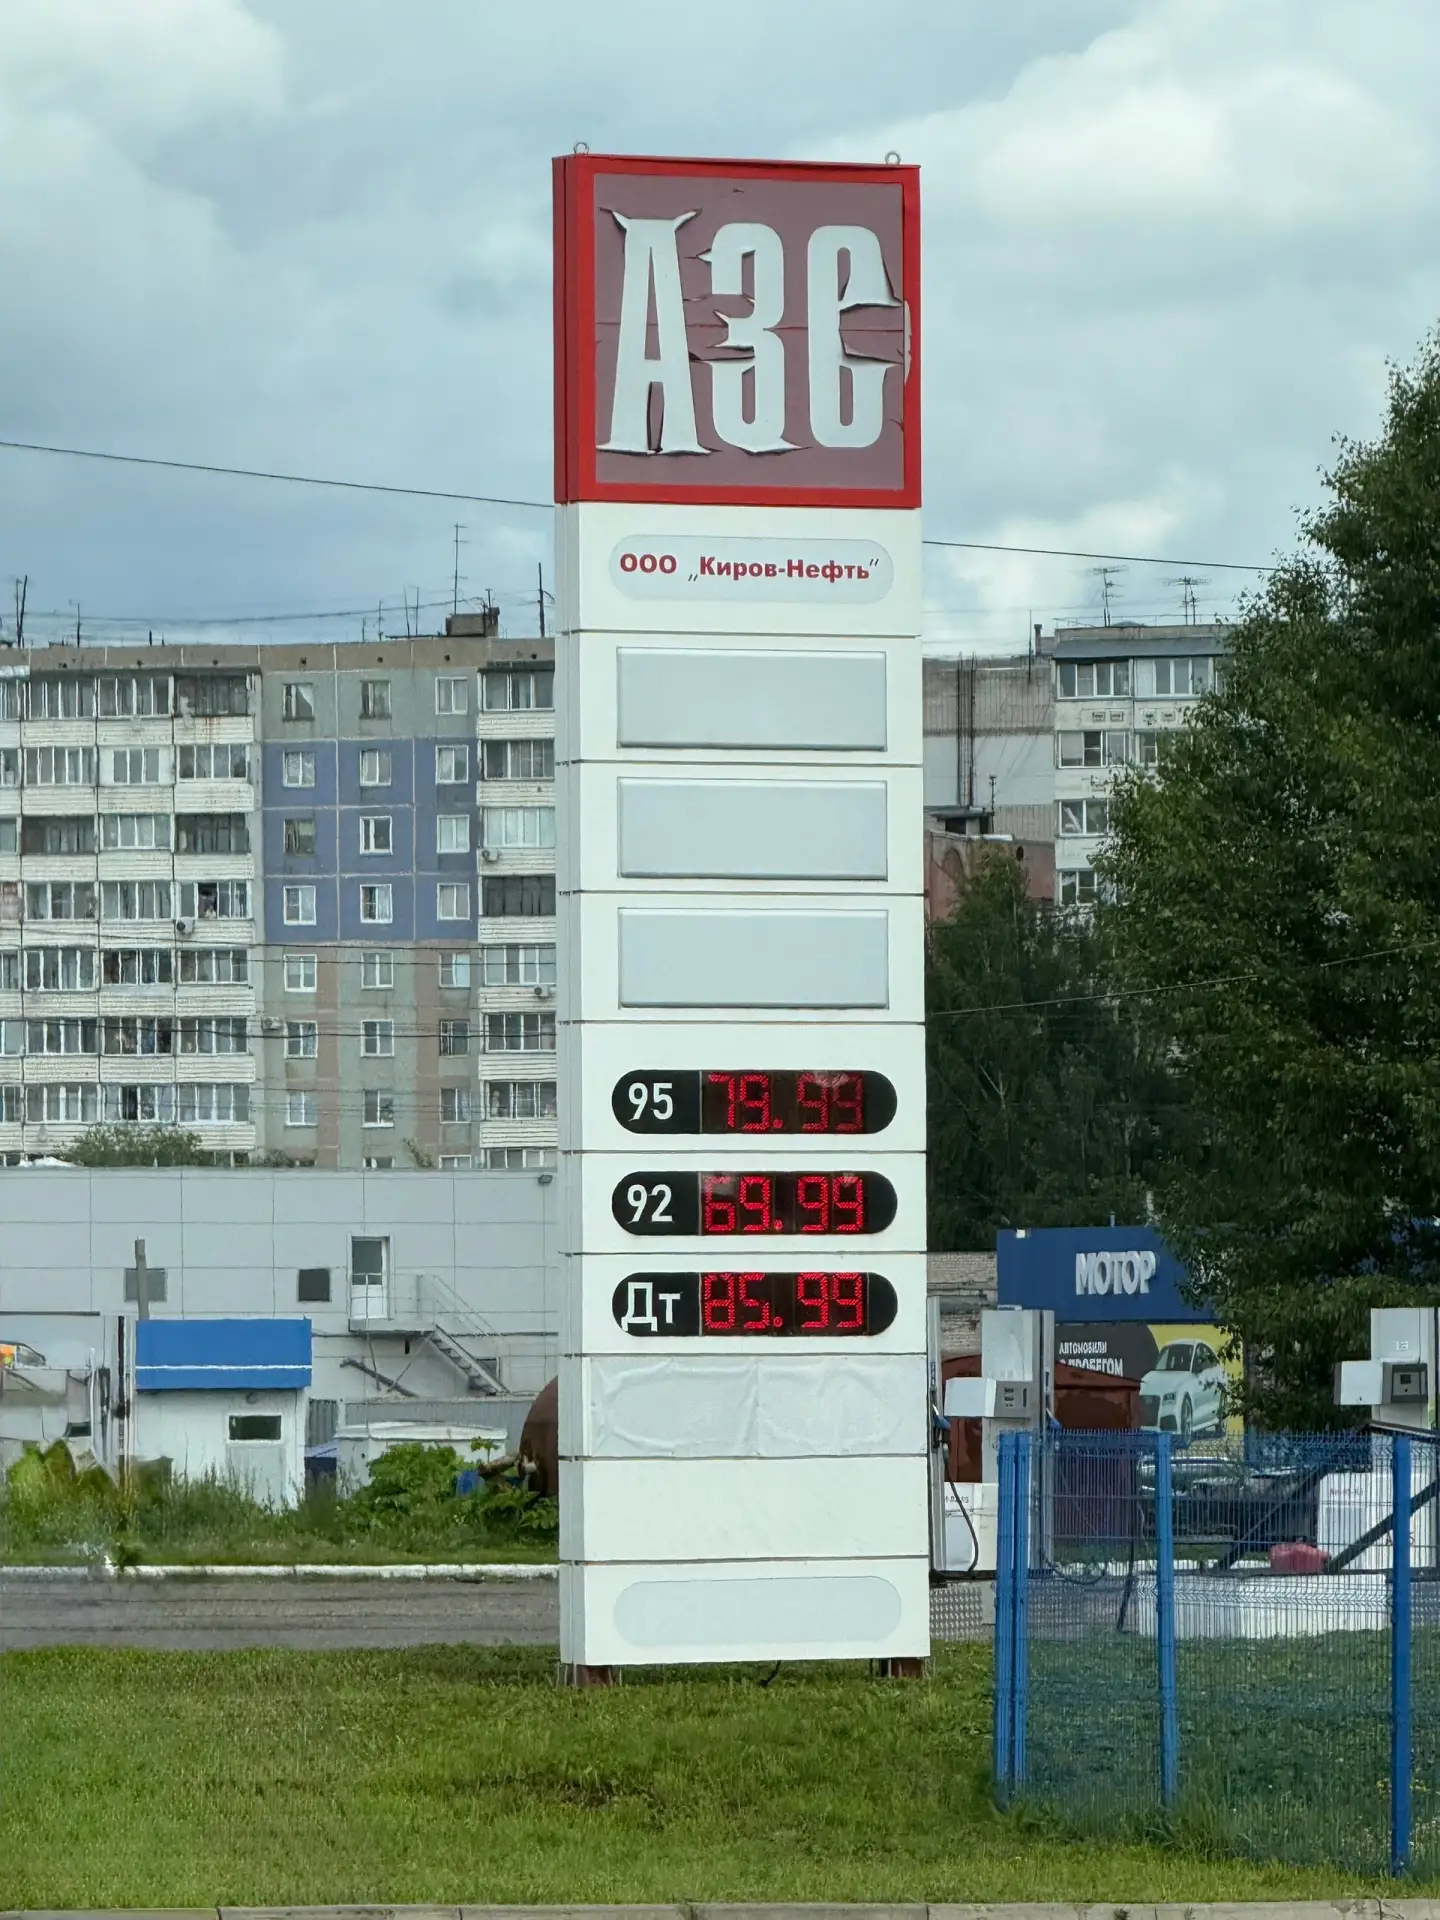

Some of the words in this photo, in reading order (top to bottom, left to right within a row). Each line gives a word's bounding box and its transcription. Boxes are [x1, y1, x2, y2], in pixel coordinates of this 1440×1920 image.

[598, 208, 903, 456] АЗС
[619, 553, 677, 574] ООО
[628, 1082, 674, 1123] 95
[708, 1072, 863, 1132] 79.99
[627, 1184, 673, 1223] 92
[704, 1176, 863, 1231] 69.99
[1075, 1250, 1157, 1295] МОТОР
[704, 1273, 863, 1329] 85.99
